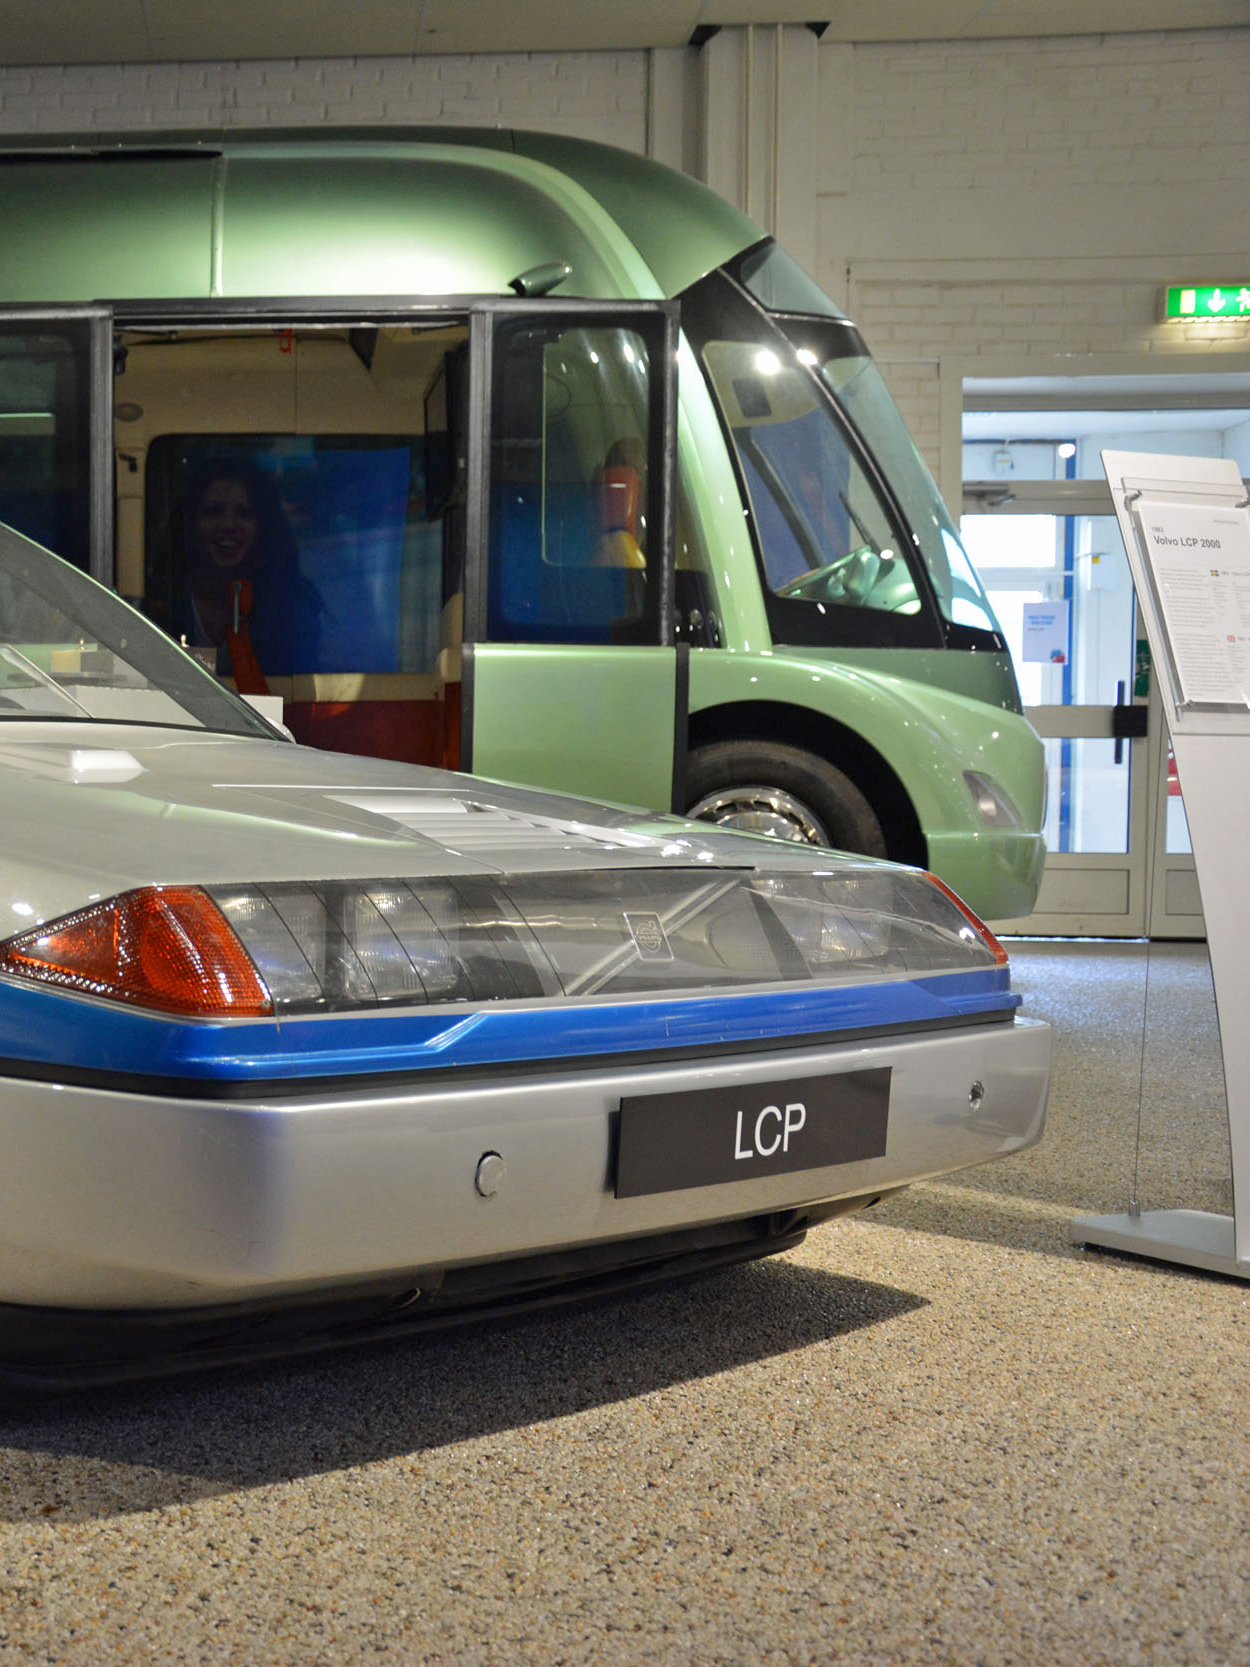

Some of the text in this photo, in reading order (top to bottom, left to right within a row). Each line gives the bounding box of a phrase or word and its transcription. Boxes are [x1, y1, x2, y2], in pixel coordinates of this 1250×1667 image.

[1153, 535, 1221, 549] Volvo LCP 2000
[733, 1102, 806, 1160] LCP
